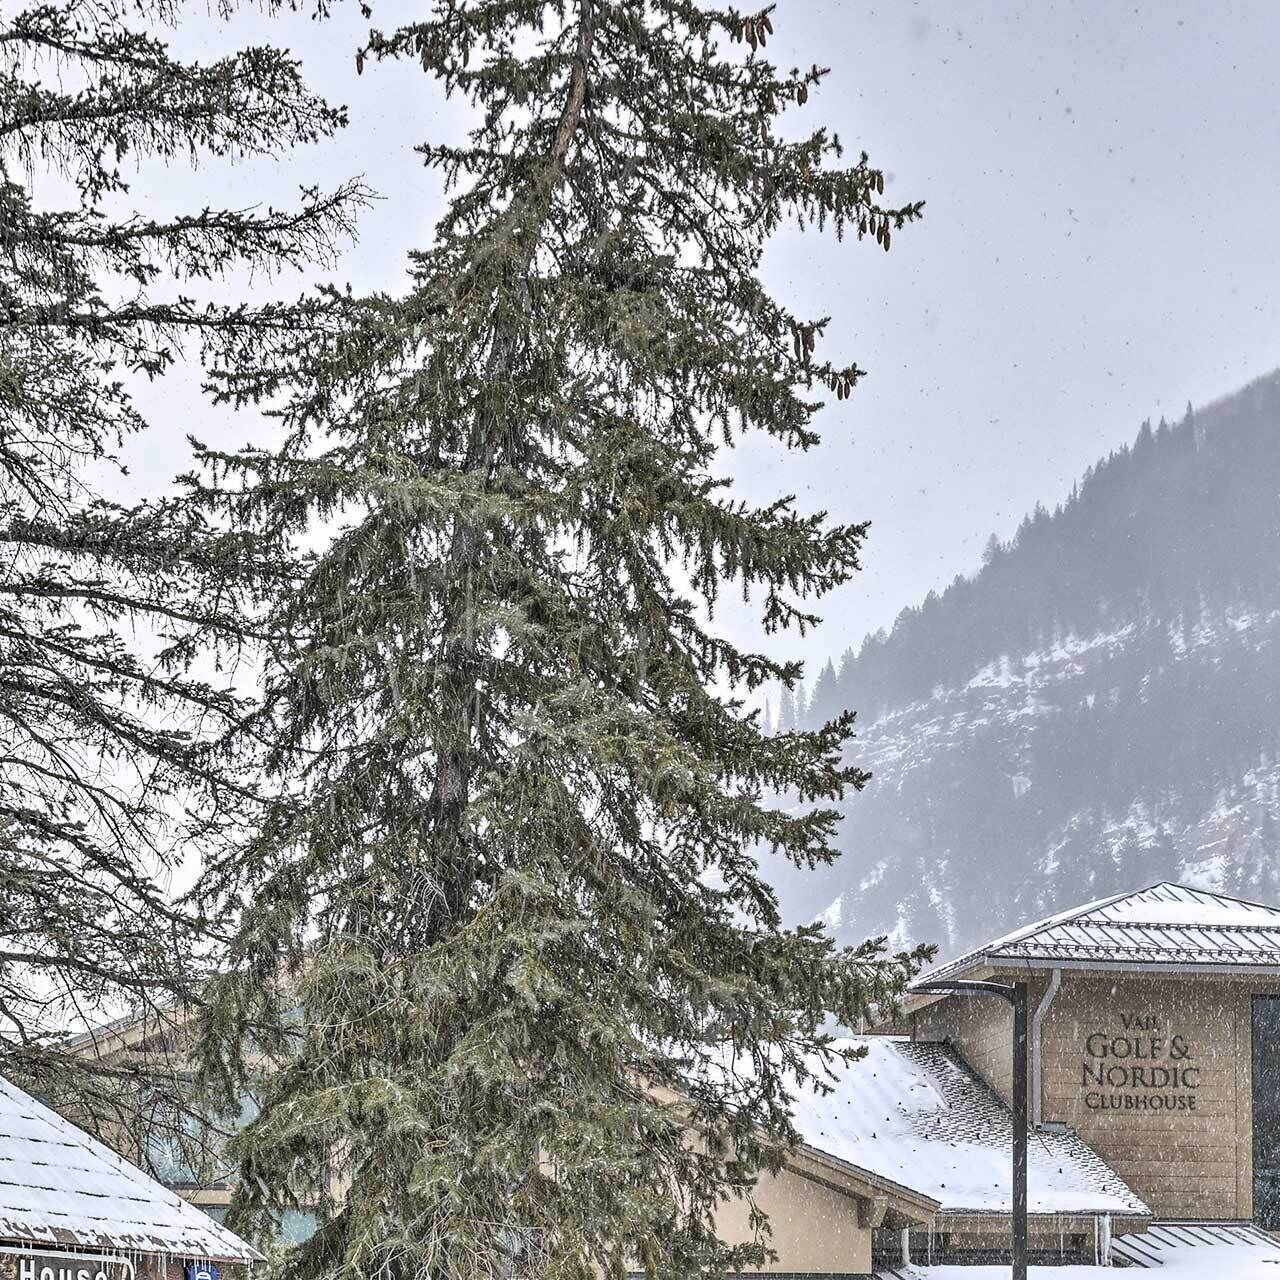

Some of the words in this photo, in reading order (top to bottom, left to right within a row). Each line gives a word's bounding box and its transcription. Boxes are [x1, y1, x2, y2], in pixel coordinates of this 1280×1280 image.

[1120, 1013, 1160, 1030] VAIL
[1086, 1033, 1162, 1059] GOLF
[1169, 1034, 1194, 1060] &
[1082, 1062, 1200, 1089] NORDIC
[1084, 1092, 1197, 1110] CLUBHOUSE
